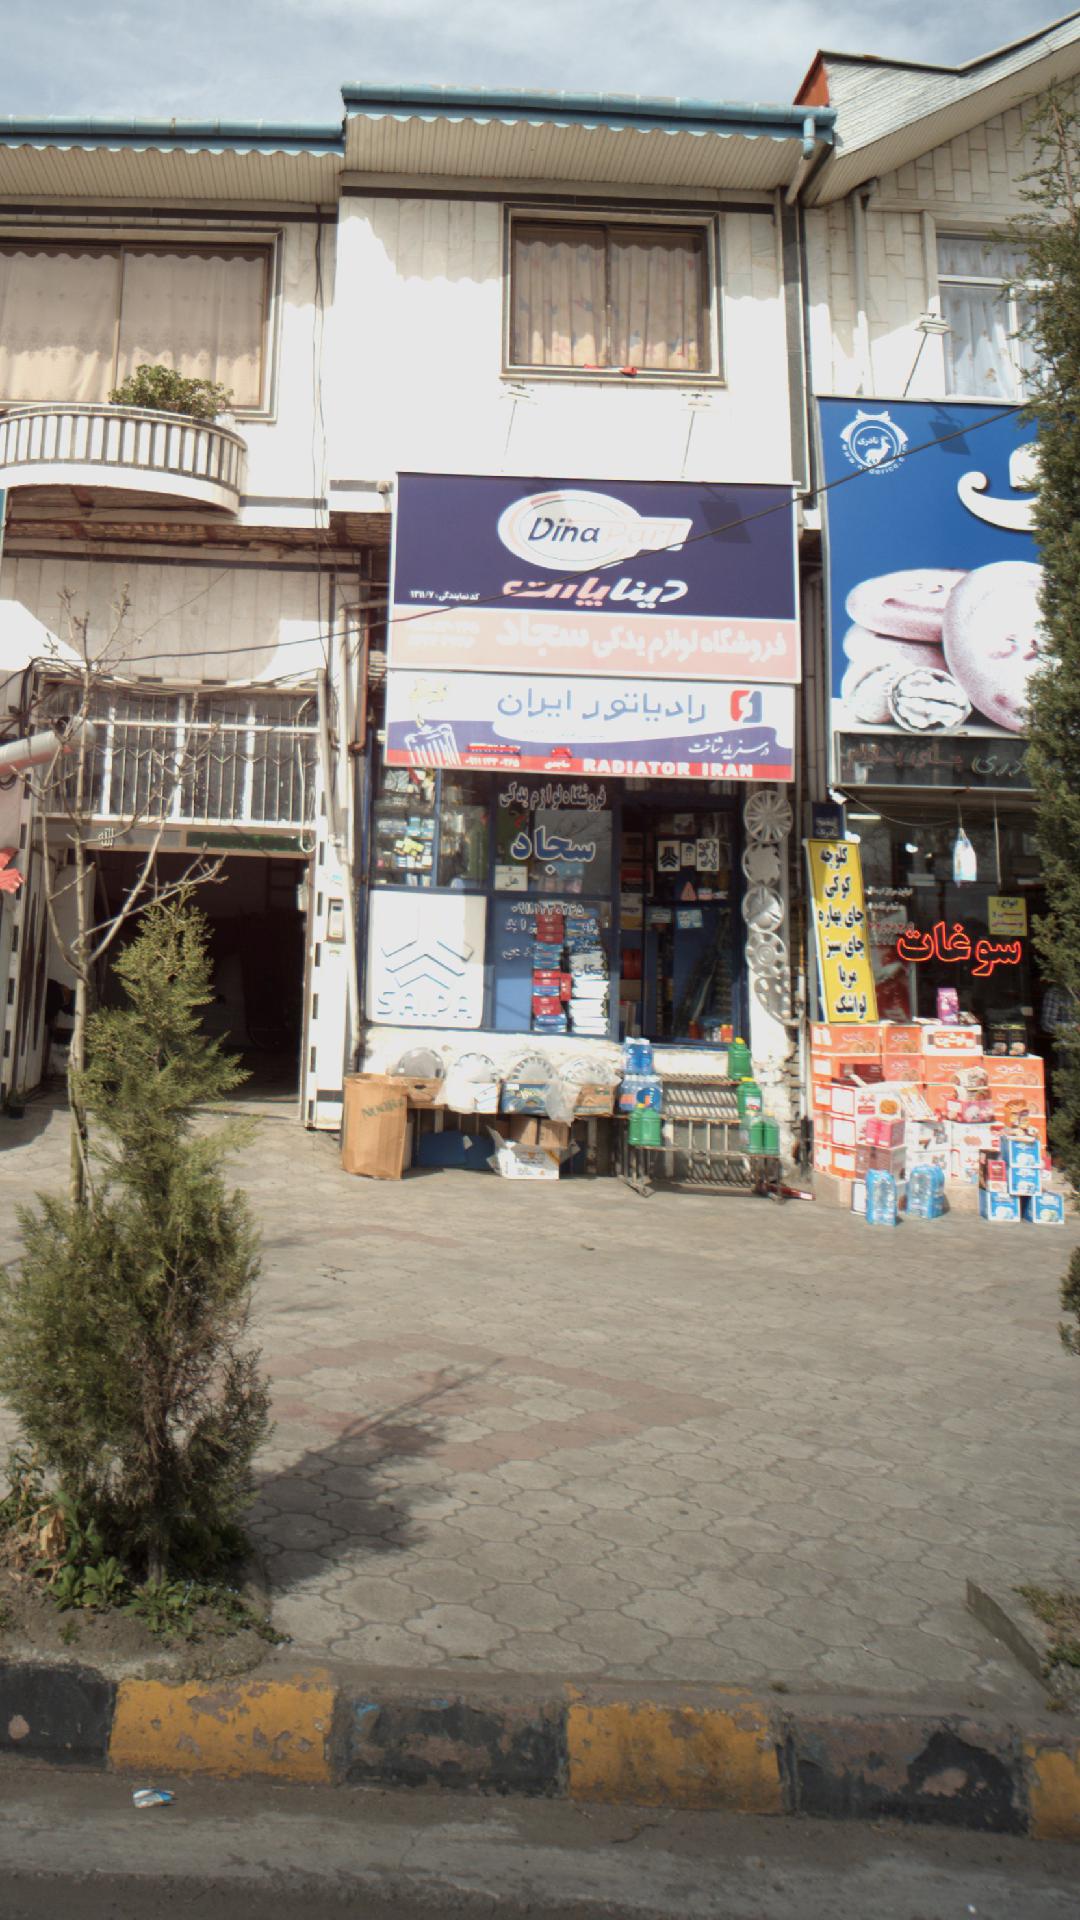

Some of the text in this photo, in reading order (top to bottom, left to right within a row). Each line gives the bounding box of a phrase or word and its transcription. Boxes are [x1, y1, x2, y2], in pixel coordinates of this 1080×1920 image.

[495, 614, 590, 655] سجاد
[593, 626, 645, 658] یدکی
[647, 629, 701, 663] لوازم
[702, 629, 787, 663] فروشگاه
[496, 687, 707, 724] رادیاتور ایران
[583, 758, 690, 777] RADIATOR
[702, 762, 753, 778] IRAN
[498, 780, 607, 812] فروشگاه لوازم یدکی
[511, 825, 597, 876] سجاد
[896, 921, 1022, 977] سوغات
